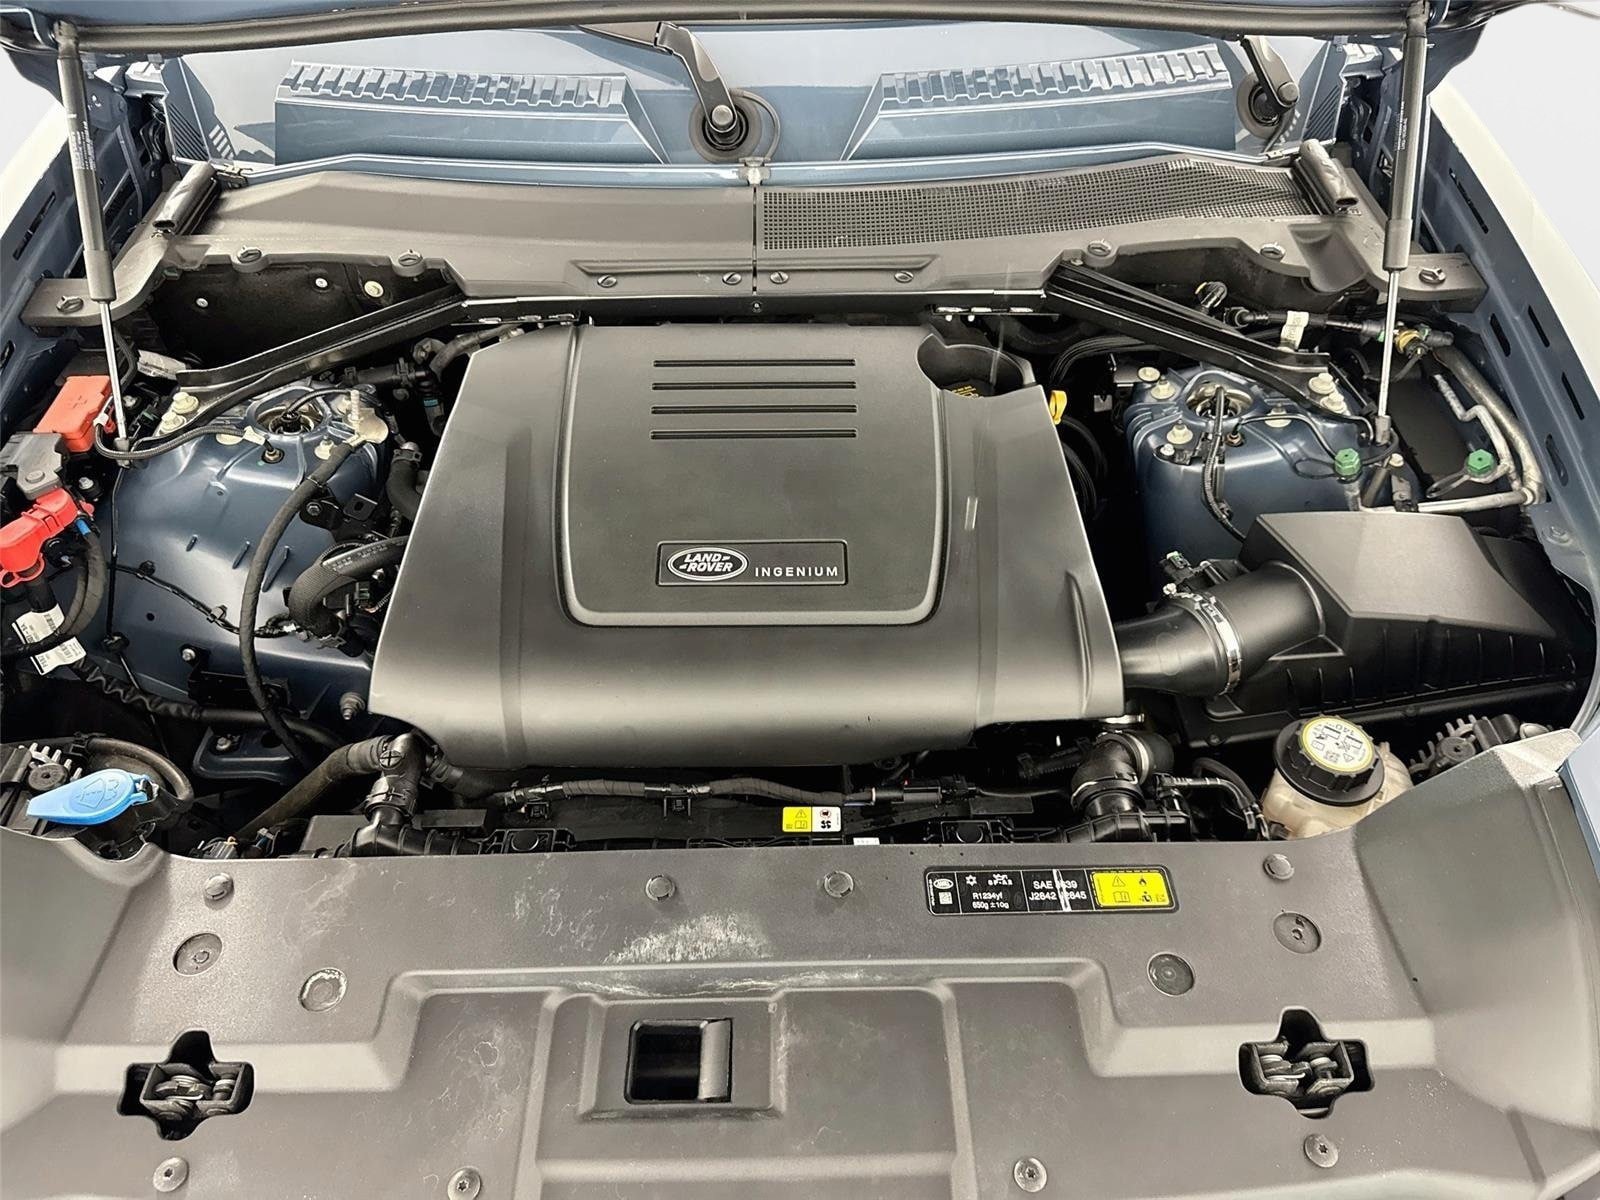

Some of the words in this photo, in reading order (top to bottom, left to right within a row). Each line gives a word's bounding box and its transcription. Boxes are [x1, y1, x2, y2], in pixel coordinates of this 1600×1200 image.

[684, 553, 722, 562] LAND
[687, 562, 733, 572] ROVER
[755, 566, 838, 577] INGENIUM
[1033, 880, 1054, 890] SAE
[1029, 891, 1057, 901] J2842
